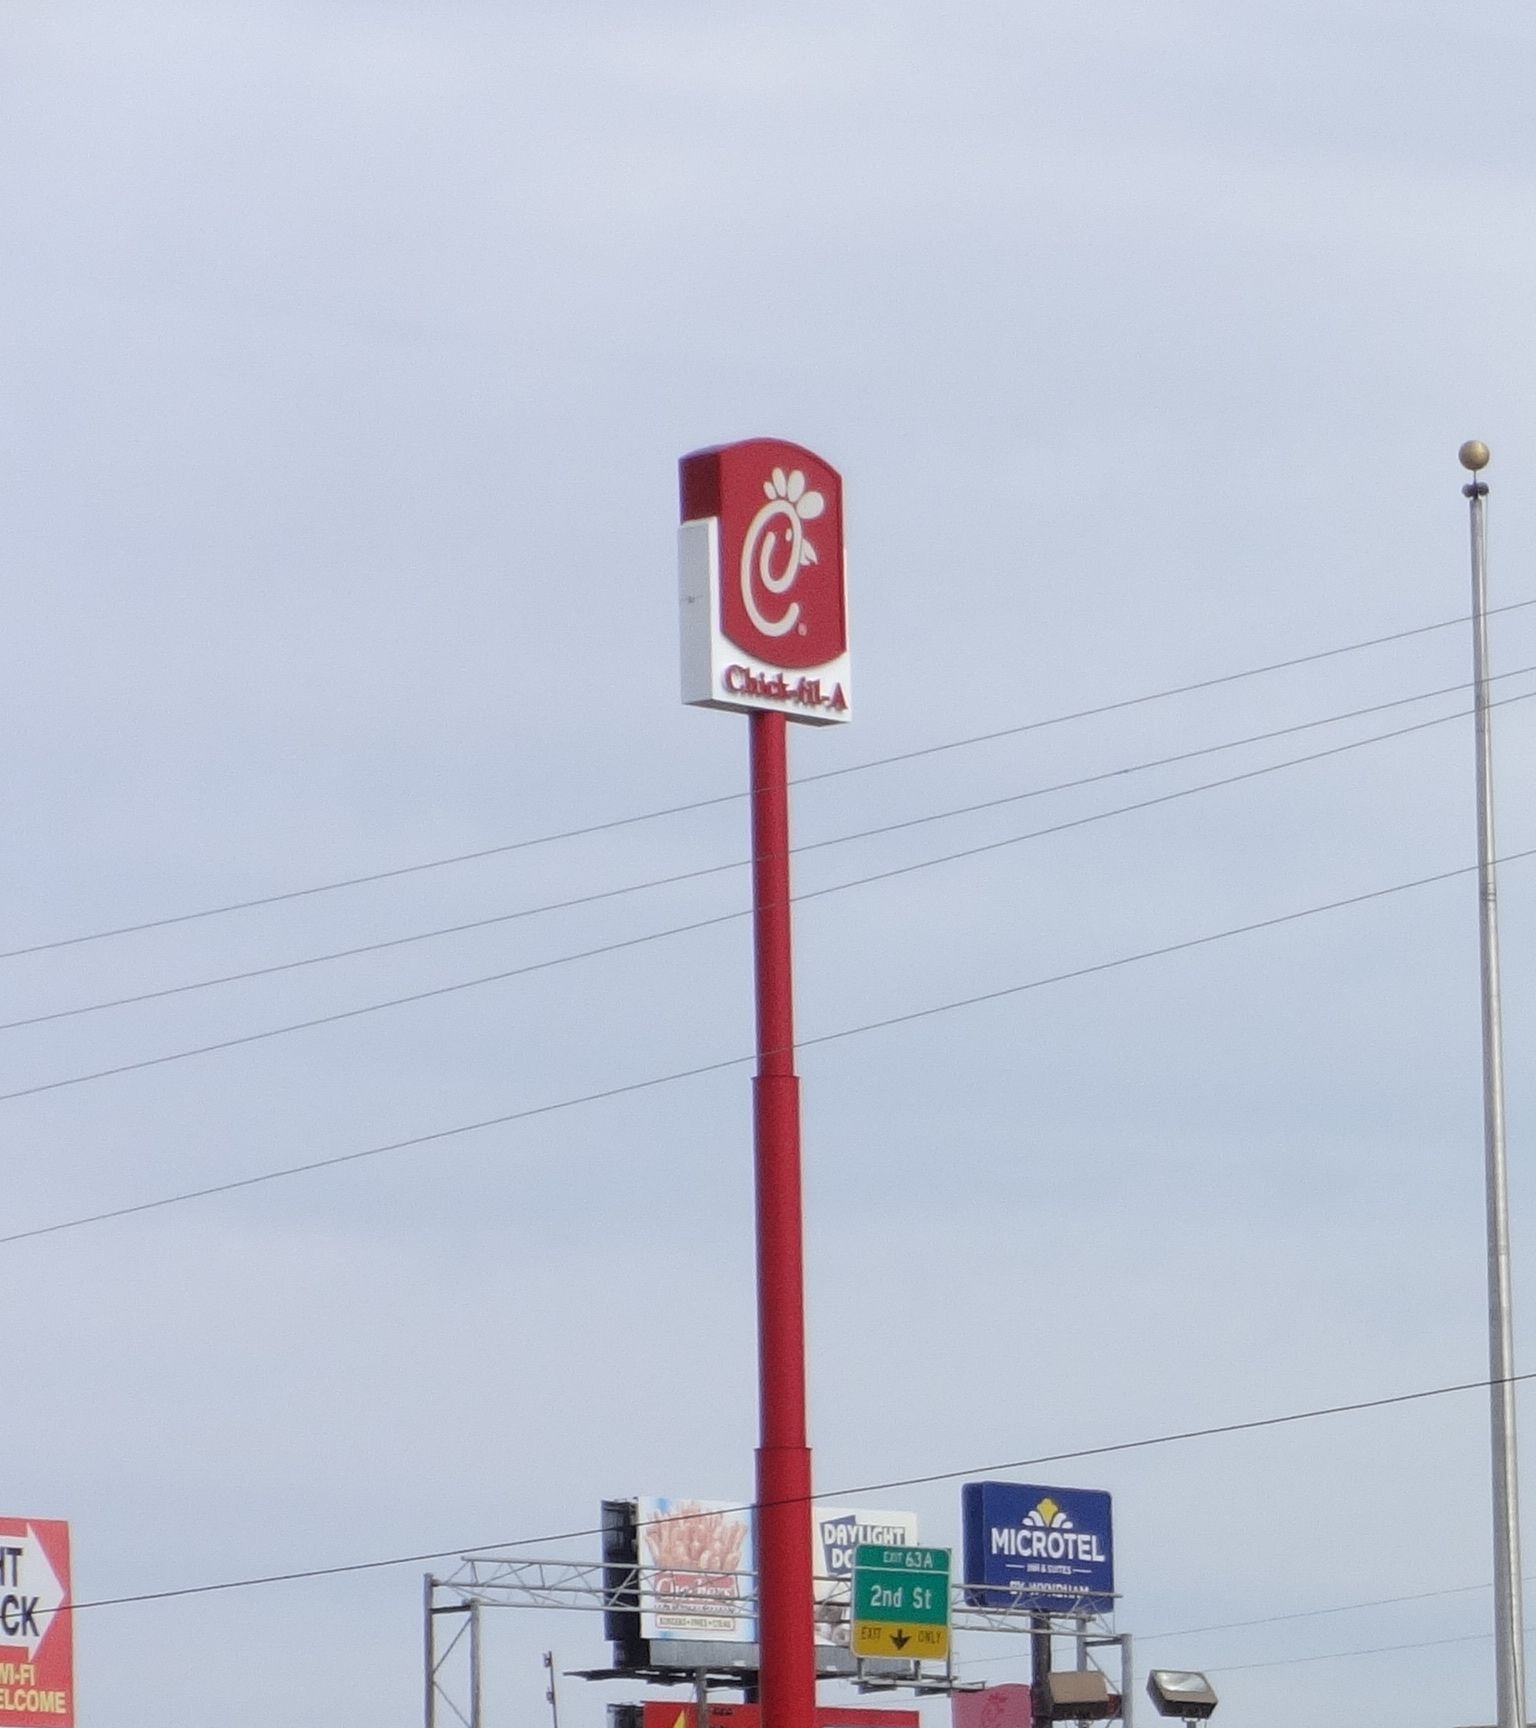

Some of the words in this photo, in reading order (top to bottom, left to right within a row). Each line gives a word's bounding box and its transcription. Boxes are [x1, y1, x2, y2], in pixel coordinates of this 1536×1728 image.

[724, 664, 848, 712] Chick-fil-A
[823, 1523, 906, 1546] DAYLIGHT
[991, 1527, 1106, 1563] MICROTEL
[904, 1551, 934, 1569] 63A
[869, 1584, 903, 1608] 2nd
[912, 1586, 933, 1610] St
[860, 1626, 882, 1641] EXIT
[917, 1630, 942, 1644] ONLY
